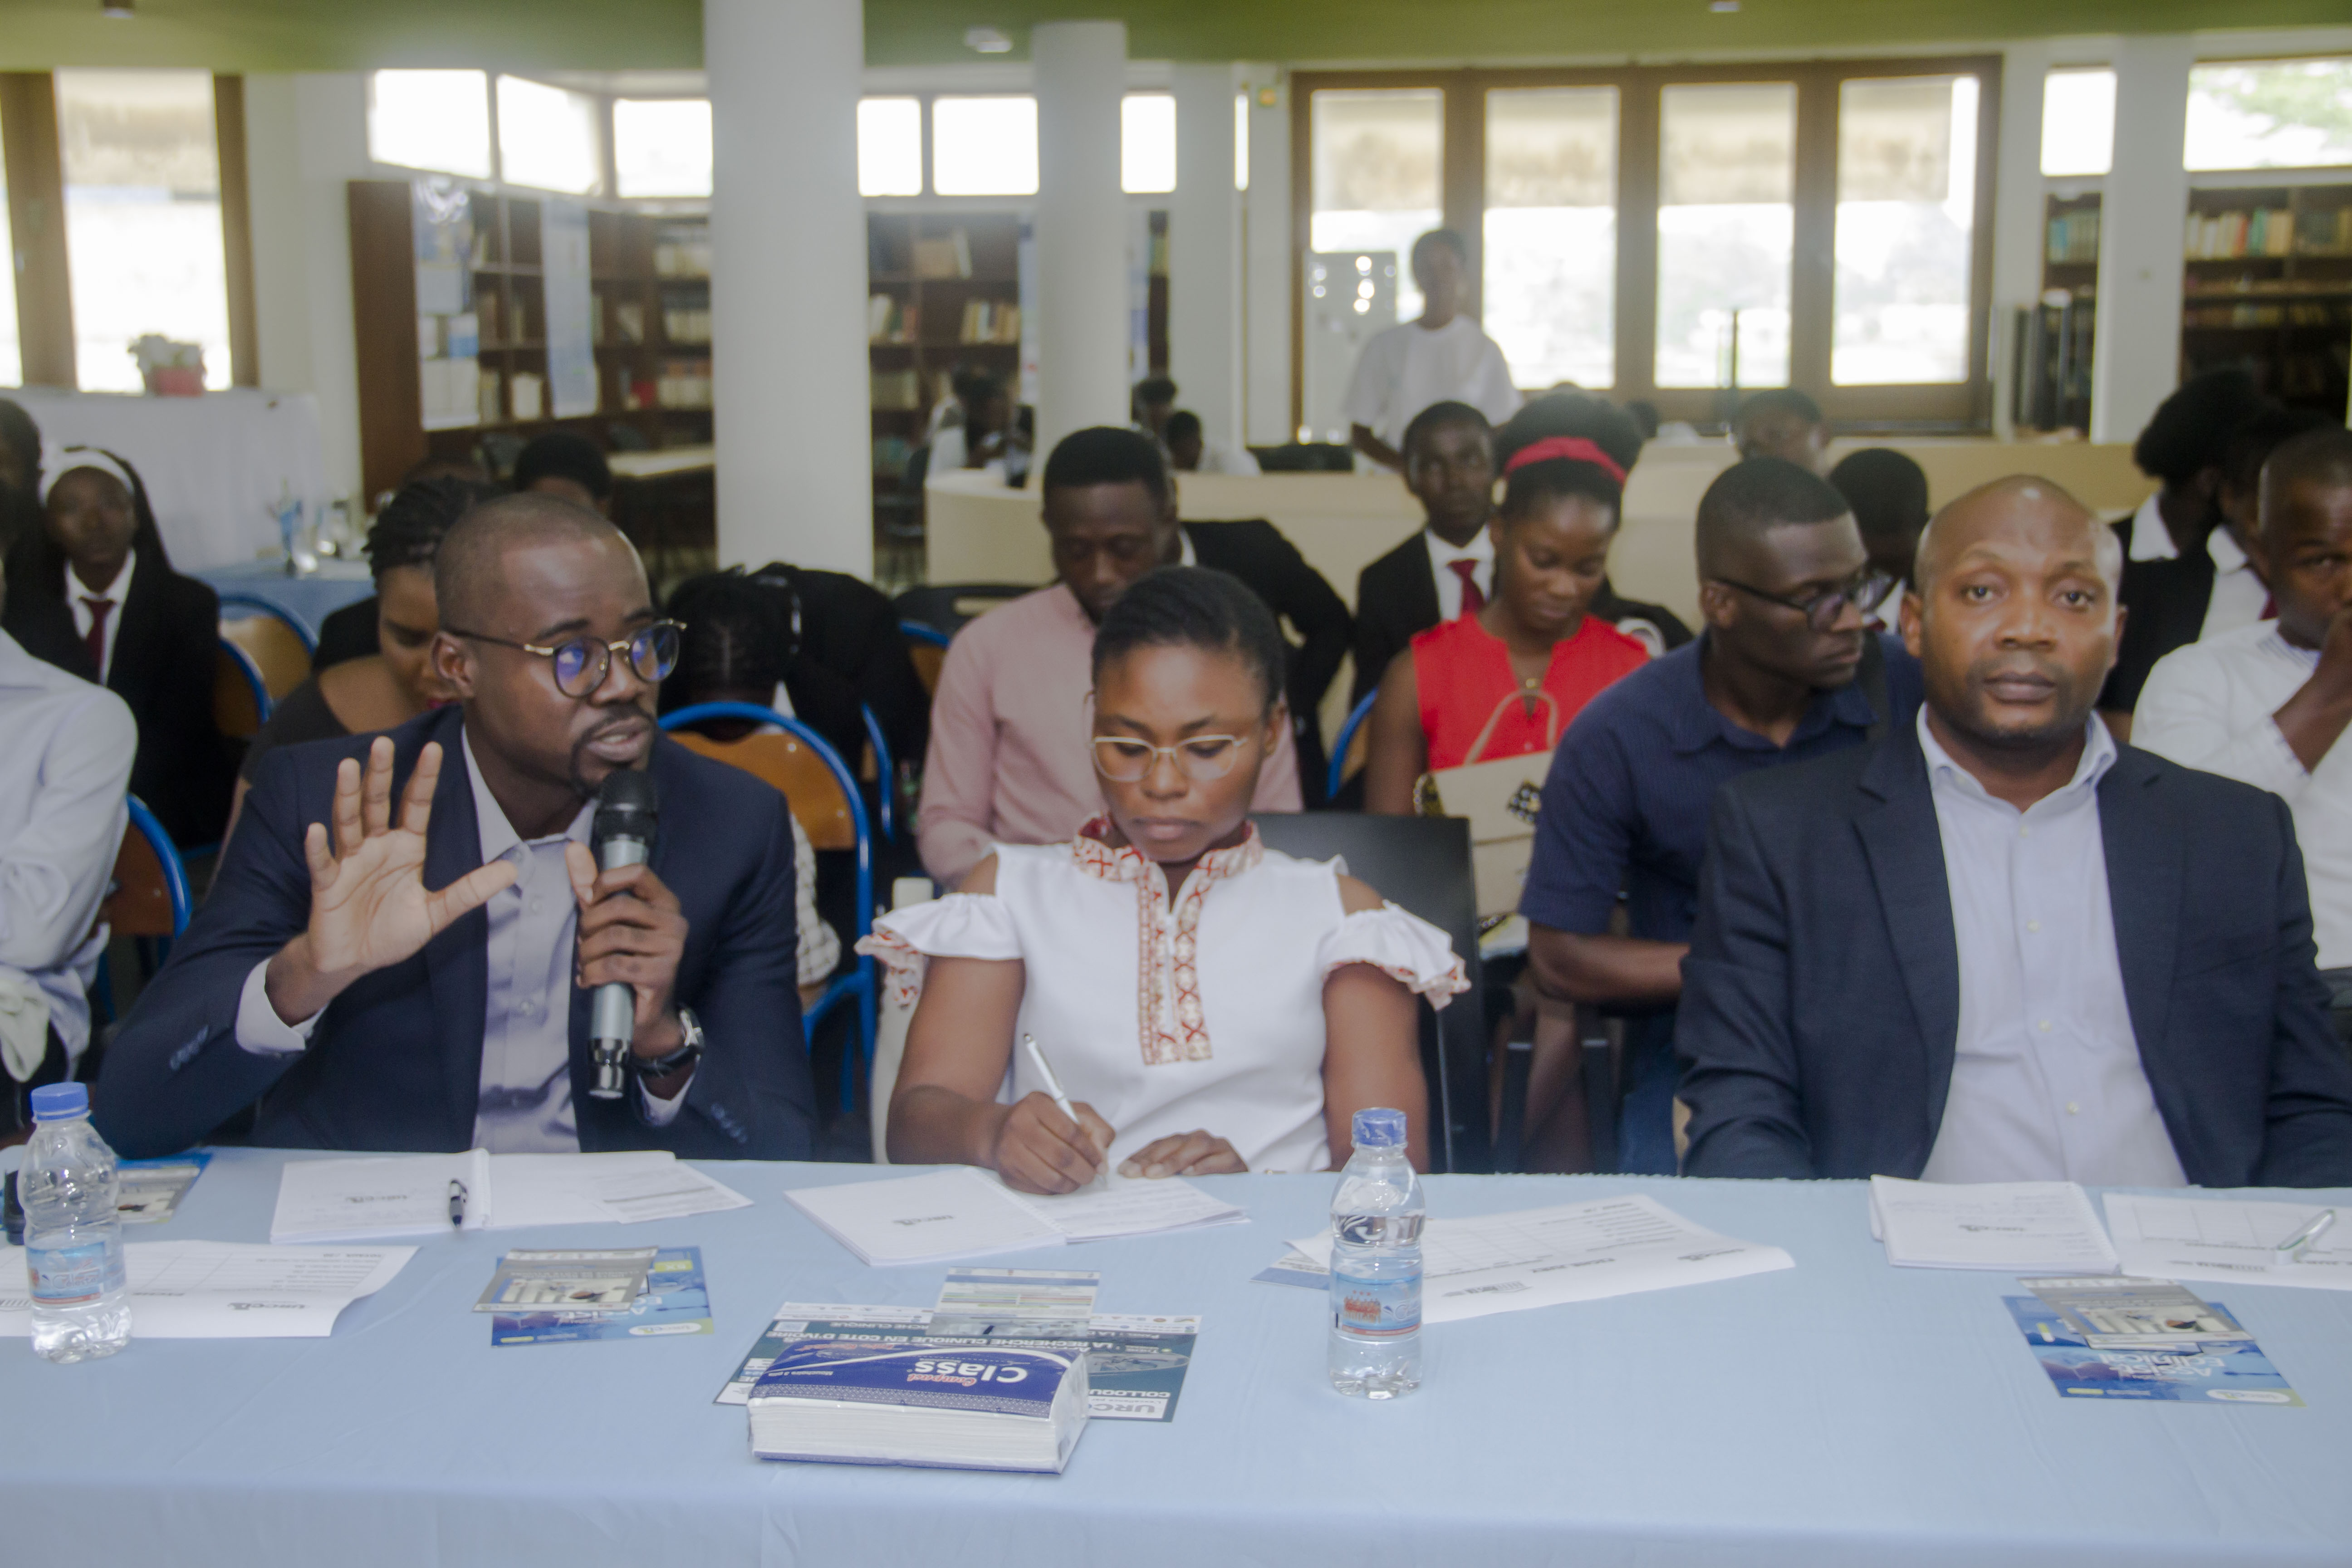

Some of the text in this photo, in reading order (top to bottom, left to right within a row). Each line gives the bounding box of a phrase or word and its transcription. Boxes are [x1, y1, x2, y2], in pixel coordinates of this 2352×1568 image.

[765, 1331, 835, 1340] D'IVOIRE
[991, 1339, 1088, 1347] RECHERCHE
[914, 1361, 1029, 1383] Class
[907, 1373, 976, 1387] Compact
[1088, 1389, 1171, 1397] COLLOQU
[1088, 1403, 1155, 1413] URC
